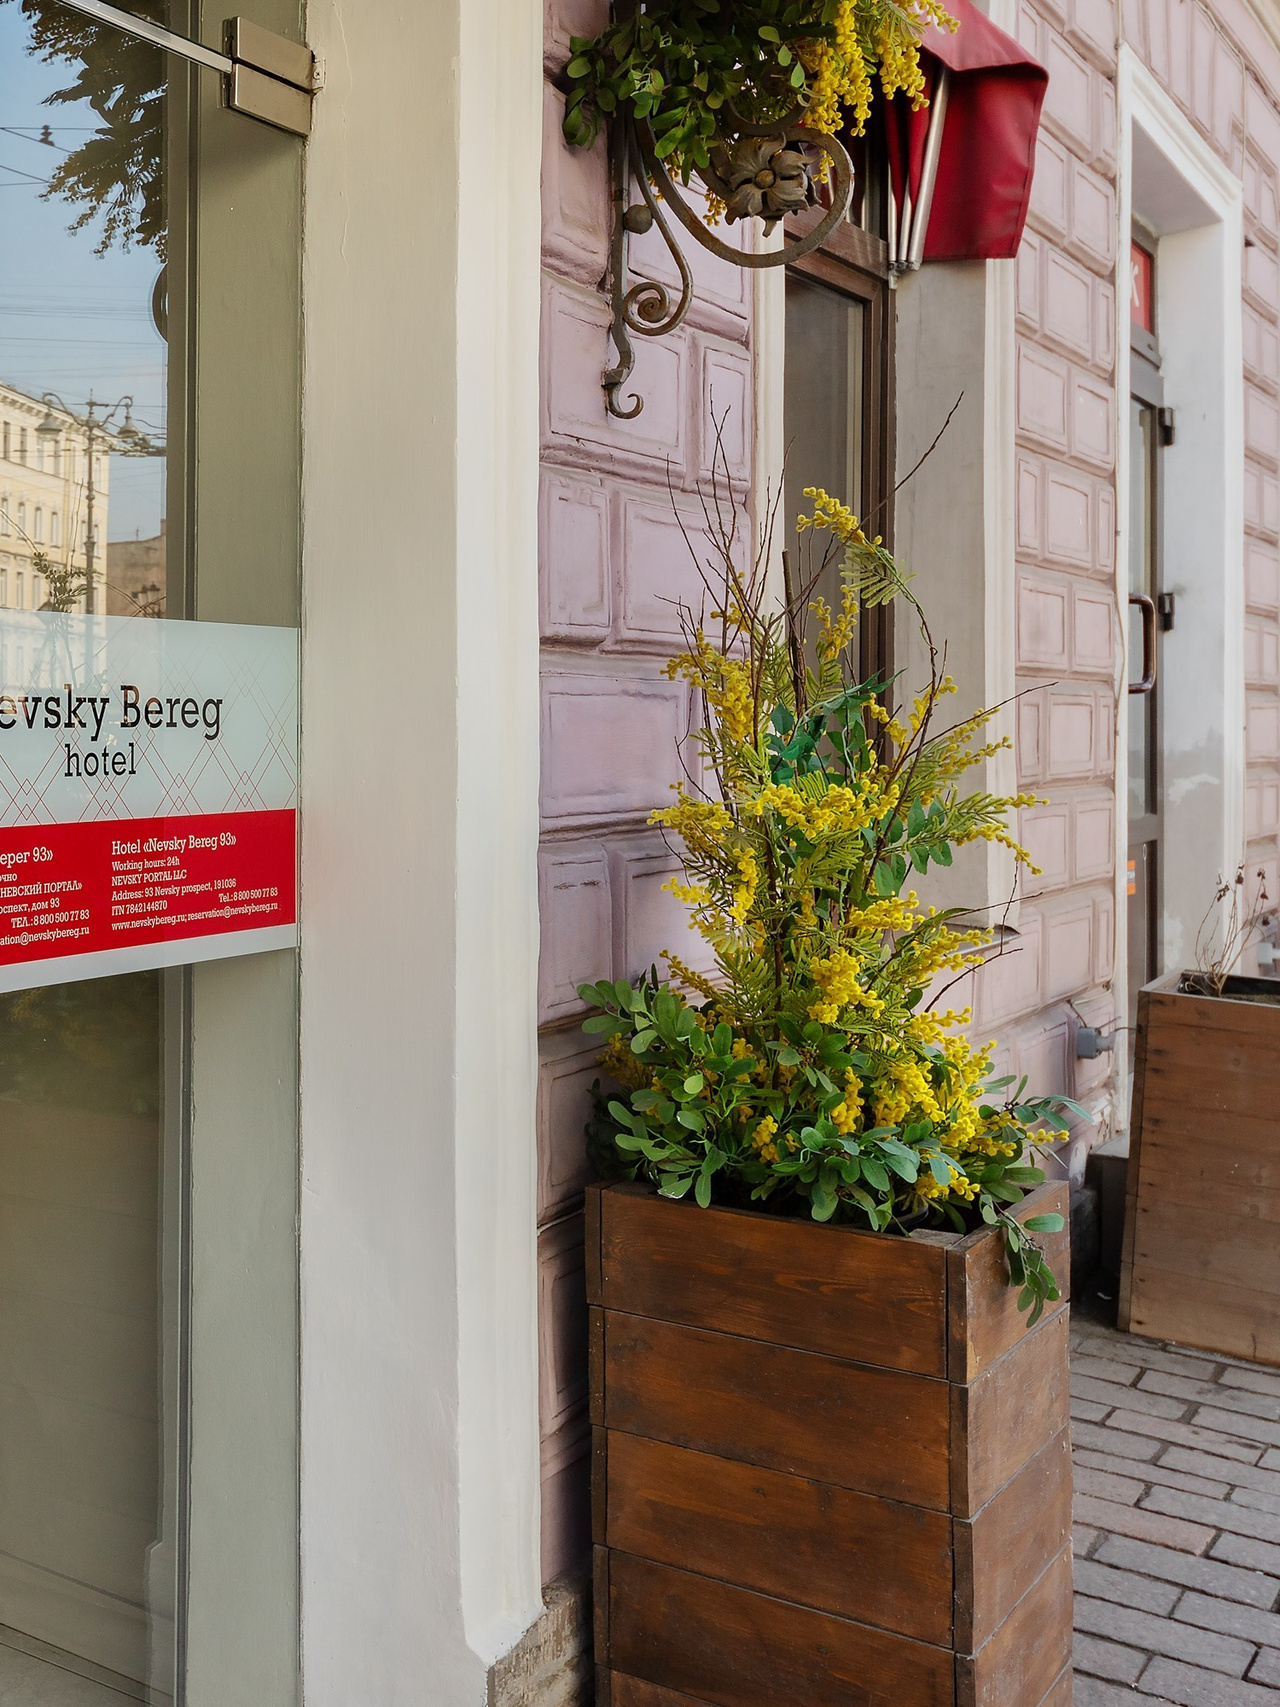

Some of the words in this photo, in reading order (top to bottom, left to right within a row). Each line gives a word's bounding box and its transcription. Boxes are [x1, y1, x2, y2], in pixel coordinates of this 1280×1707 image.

[120, 684, 223, 741] Bereg
[64, 742, 137, 777] hotel
[111, 839, 141, 855] Hotel
[143, 836, 187, 853] «Nevsky
[188, 834, 218, 851] Bereg
[219, 831, 237, 847] 93»
[32, 846, 54, 862] 93»
[111, 860, 143, 872] Working
[144, 858, 166, 869] hours:
[167, 856, 180, 867] 24h
[43, 880, 83, 894] ПОРТАЛ»
[111, 873, 142, 887] NEVSKY
[143, 870, 173, 883] PORTAL
[173, 869, 187, 880] LLC
[111, 890, 144, 902] Address:
[144, 887, 154, 898] 93
[154, 885, 181, 897] Nevsky
[181, 881, 213, 896] prospect,
[213, 878, 237, 890] 191036
[31, 900, 49, 912] дом
[49, 897, 60, 908] 93
[111, 904, 125, 916] ITN
[125, 900, 168, 915] 7842144870
[187, 902, 278, 921] reservation@nevskybereg.ru
